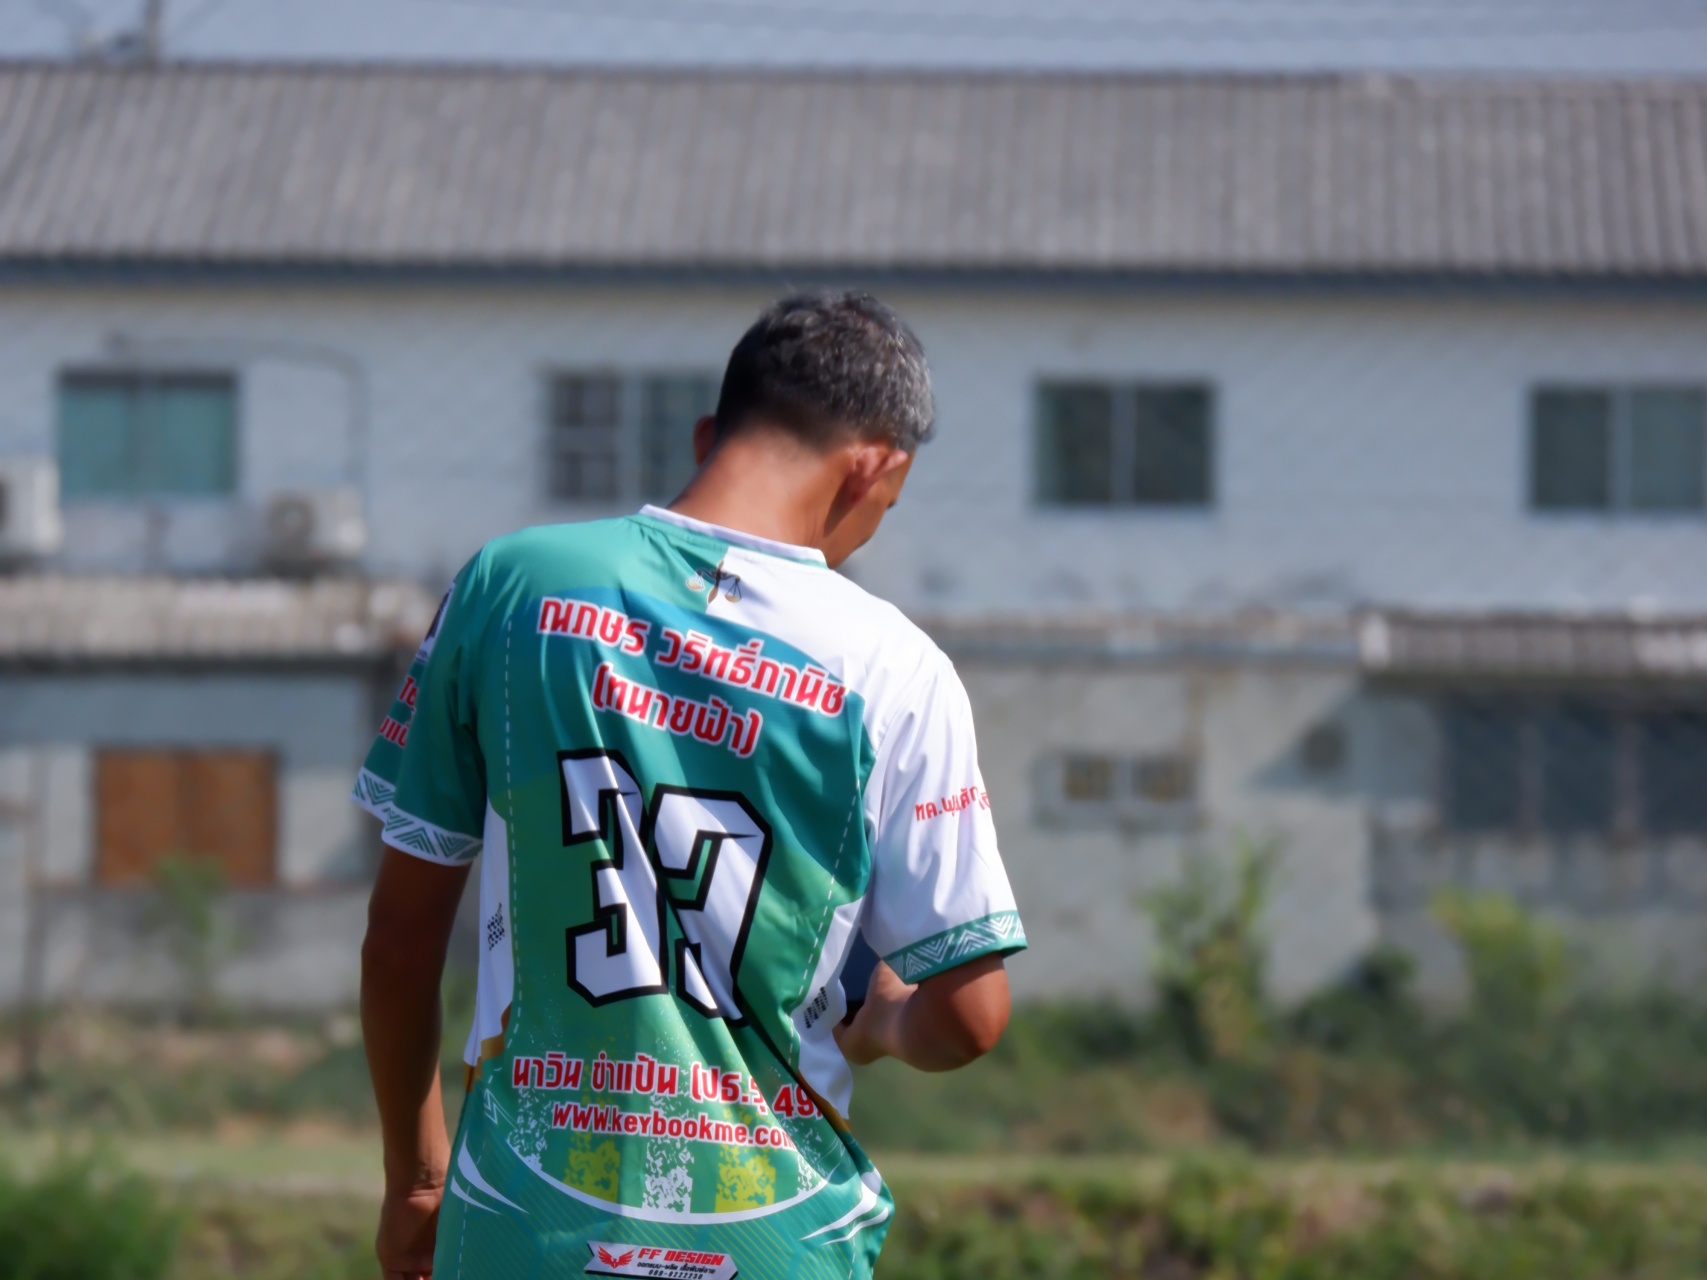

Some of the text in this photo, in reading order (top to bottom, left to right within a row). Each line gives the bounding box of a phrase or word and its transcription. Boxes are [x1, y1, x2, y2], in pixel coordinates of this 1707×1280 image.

[512, 1051, 583, 1089] นาวิน
[638, 1248, 724, 1265] FF DESIGN
